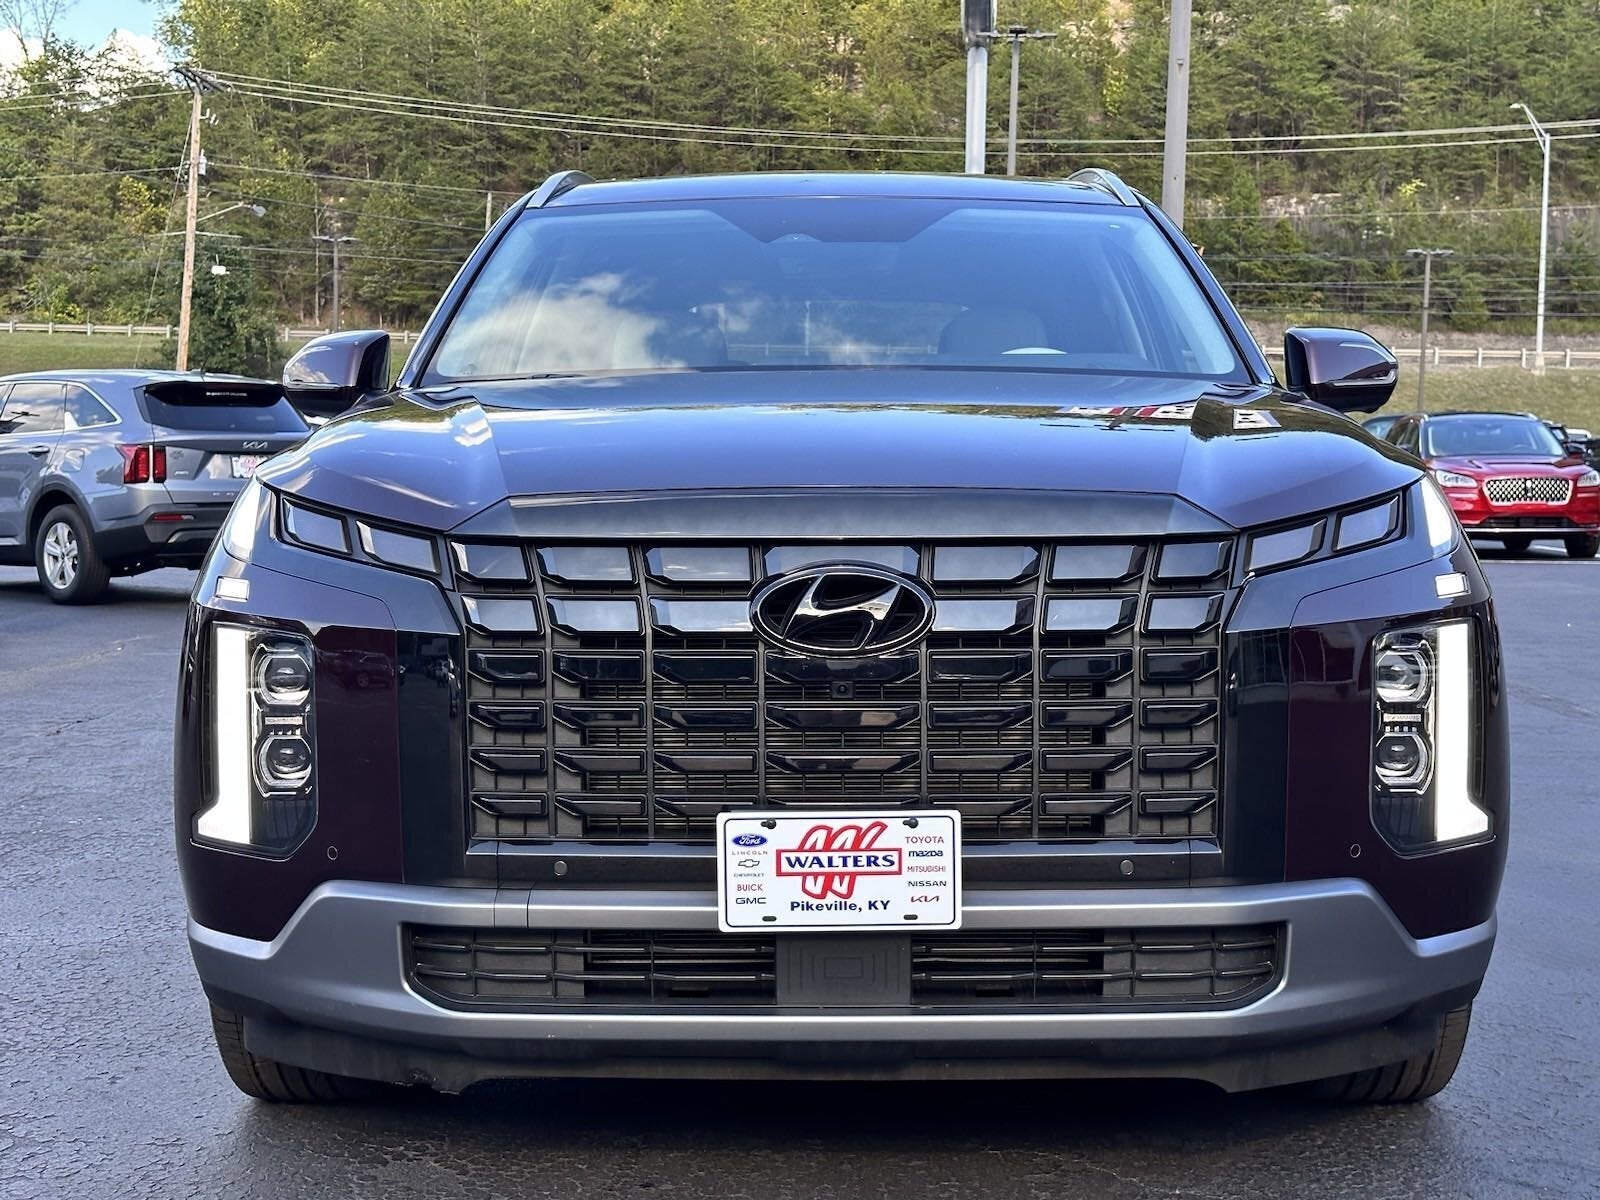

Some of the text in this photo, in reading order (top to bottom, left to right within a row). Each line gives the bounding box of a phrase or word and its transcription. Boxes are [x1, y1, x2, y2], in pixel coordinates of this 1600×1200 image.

[737, 834, 763, 846] Ford
[905, 836, 944, 844] TOYOTA
[785, 854, 896, 869] WALTERS
[907, 865, 946, 873] MITSUBISHI
[737, 884, 763, 892] BUICK
[735, 897, 767, 905] GMC
[910, 895, 940, 903] KIA
[790, 900, 891, 912] Pikeville, KY
